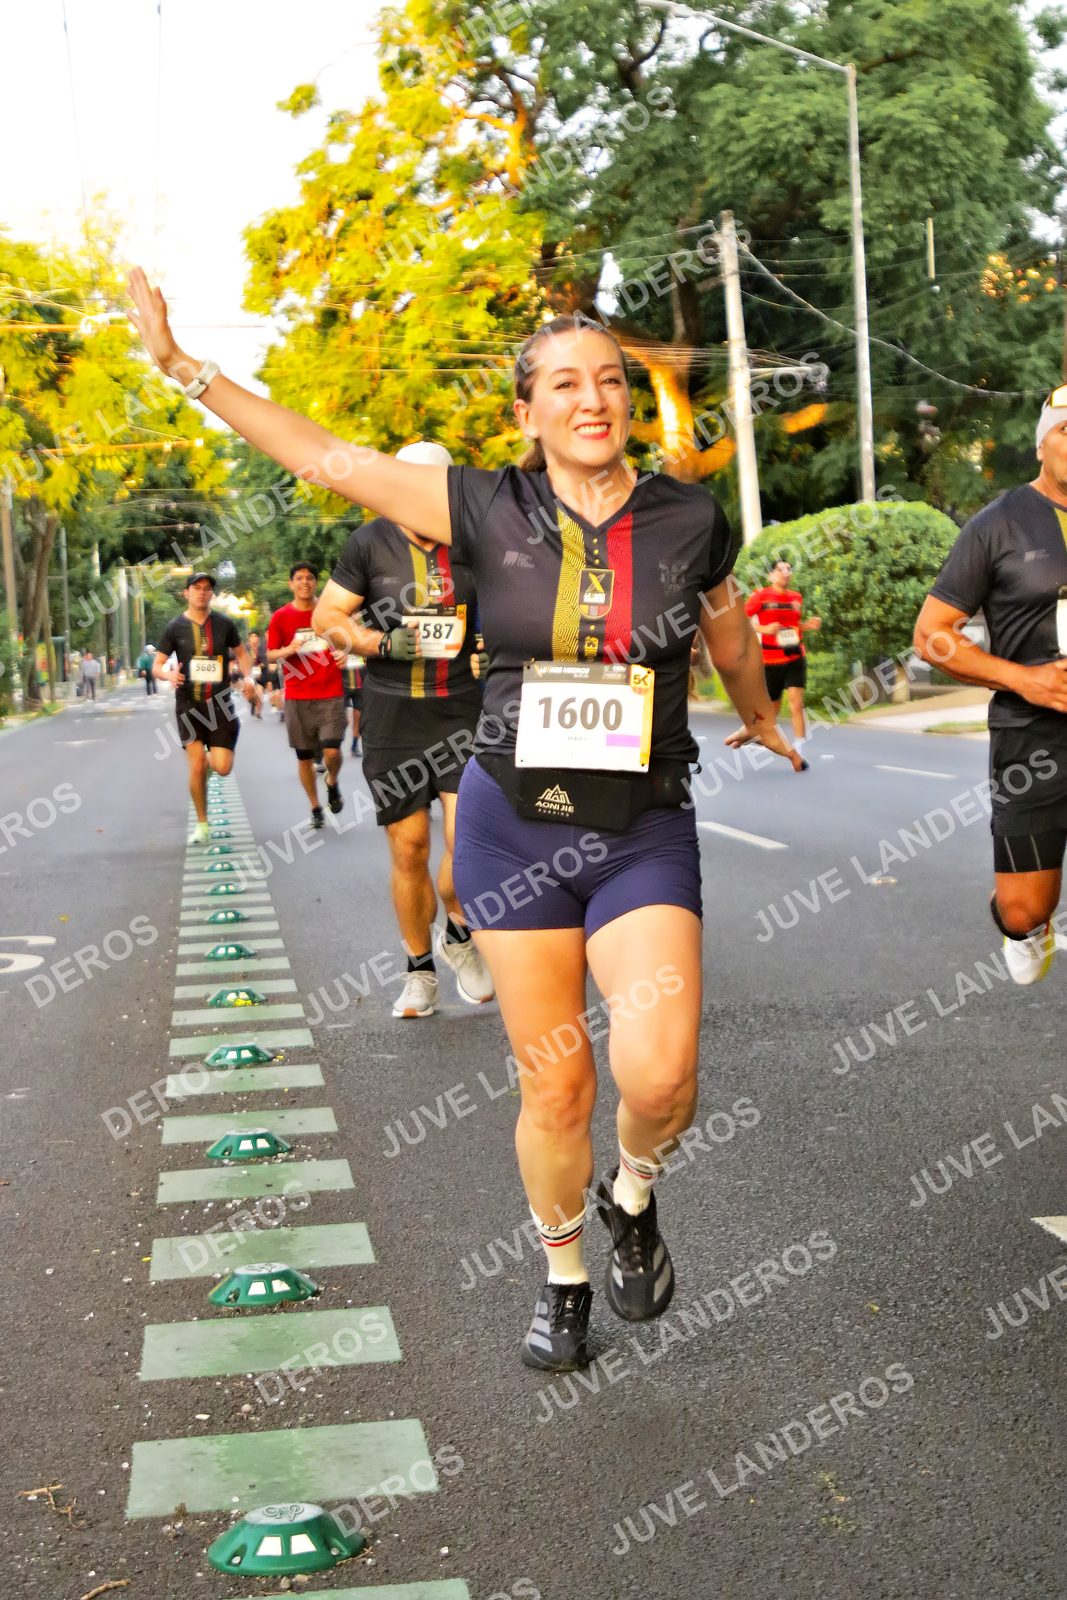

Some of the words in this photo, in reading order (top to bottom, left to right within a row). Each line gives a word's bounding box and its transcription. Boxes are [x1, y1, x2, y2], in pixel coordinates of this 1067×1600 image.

[422, 623, 454, 640] 587
[633, 674, 649, 686] 5K
[538, 696, 623, 731] 1600
[535, 800, 575, 813] AONIJIE
